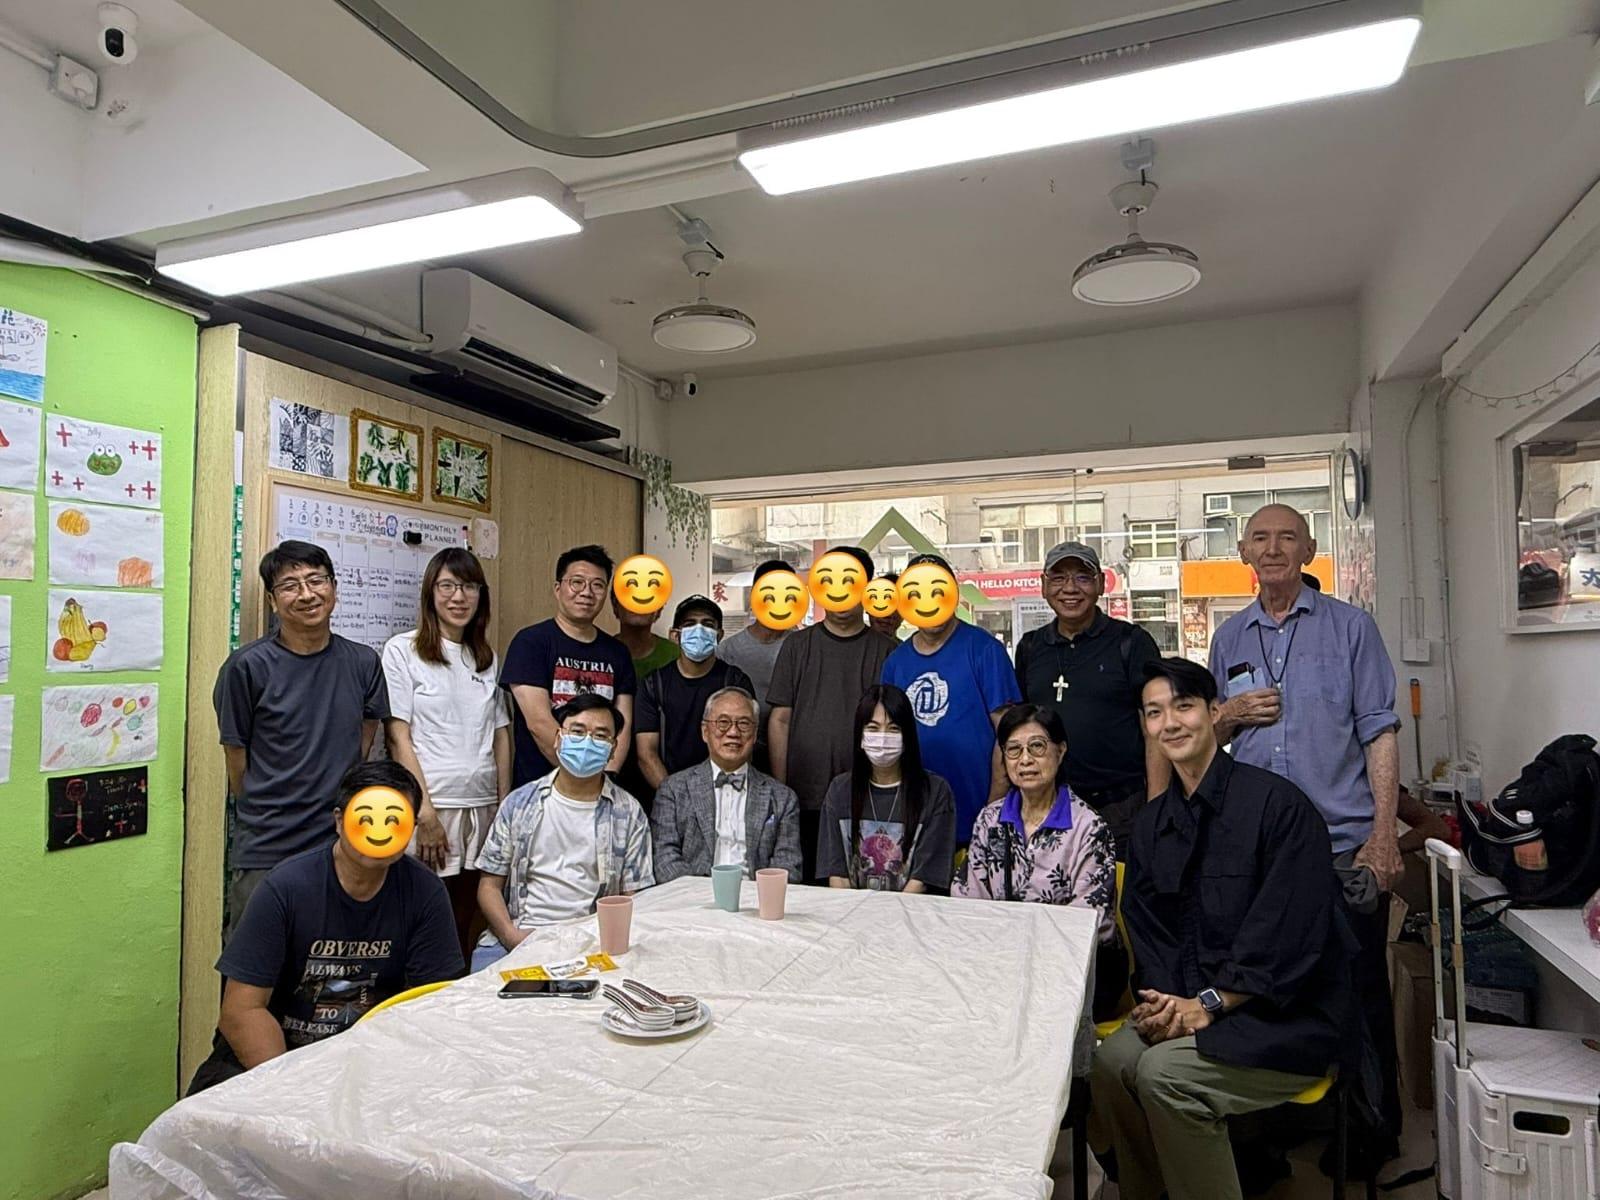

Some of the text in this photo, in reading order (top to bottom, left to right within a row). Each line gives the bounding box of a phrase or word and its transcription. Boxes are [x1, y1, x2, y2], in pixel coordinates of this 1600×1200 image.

[423, 522, 457, 535] MONTHLY
[424, 533, 457, 544] PLANNER
[980, 579, 1012, 589] HELLO
[712, 581, 729, 603] 家
[555, 656, 615, 673] AUSTRIA
[310, 940, 392, 957] OBVERSE
[304, 963, 362, 977] ALWAYS
[319, 1007, 338, 1020] TO
